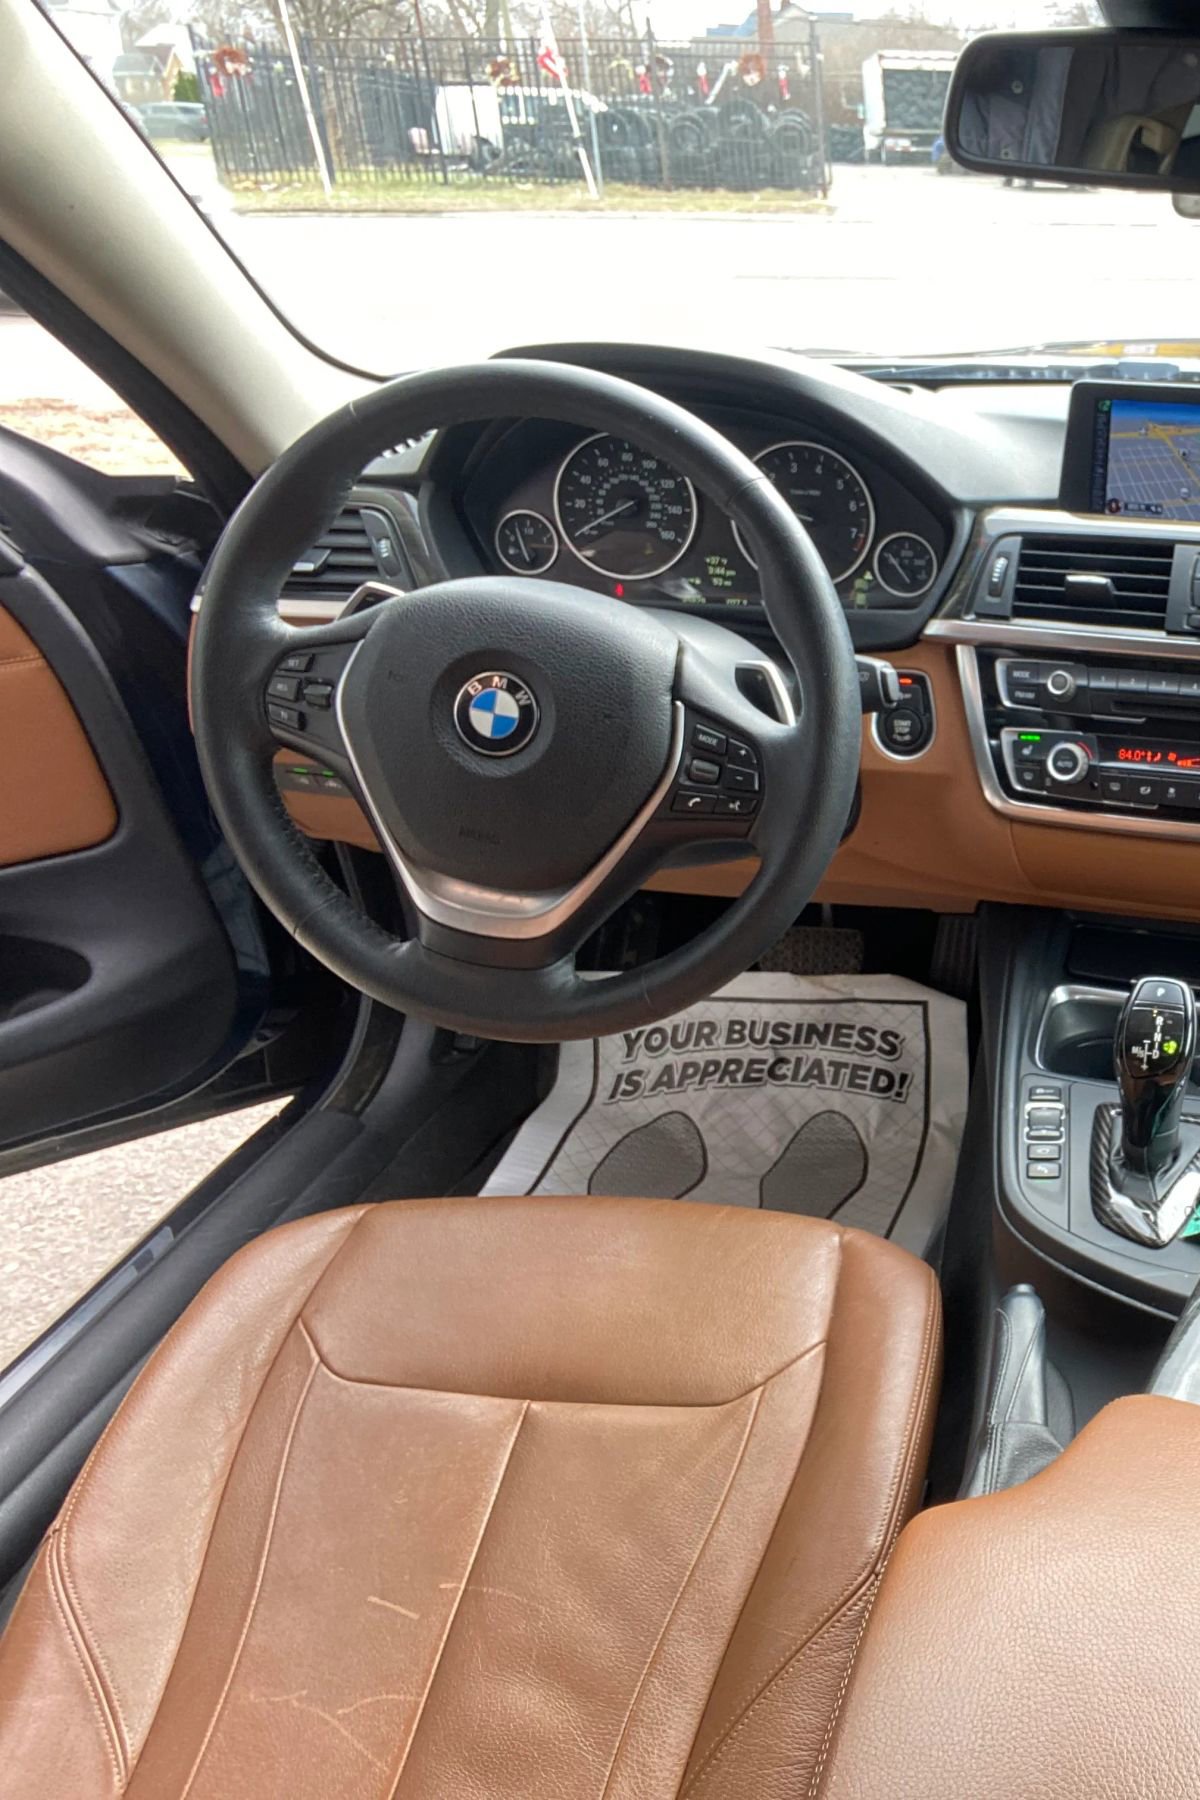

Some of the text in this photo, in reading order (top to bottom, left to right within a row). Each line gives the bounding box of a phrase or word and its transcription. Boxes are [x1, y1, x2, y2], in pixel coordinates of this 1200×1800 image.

[466, 675, 531, 706] BMW
[894, 719, 912, 727] START
[698, 733, 719, 747] MODE
[1156, 987, 1166, 997] P
[1155, 1016, 1164, 1026] R
[622, 1019, 904, 1062] YOUR BUSINESS
[1153, 1032, 1162, 1042] N
[1152, 1049, 1160, 1059] D
[609, 1056, 912, 1102] IS APPRECIATED!
